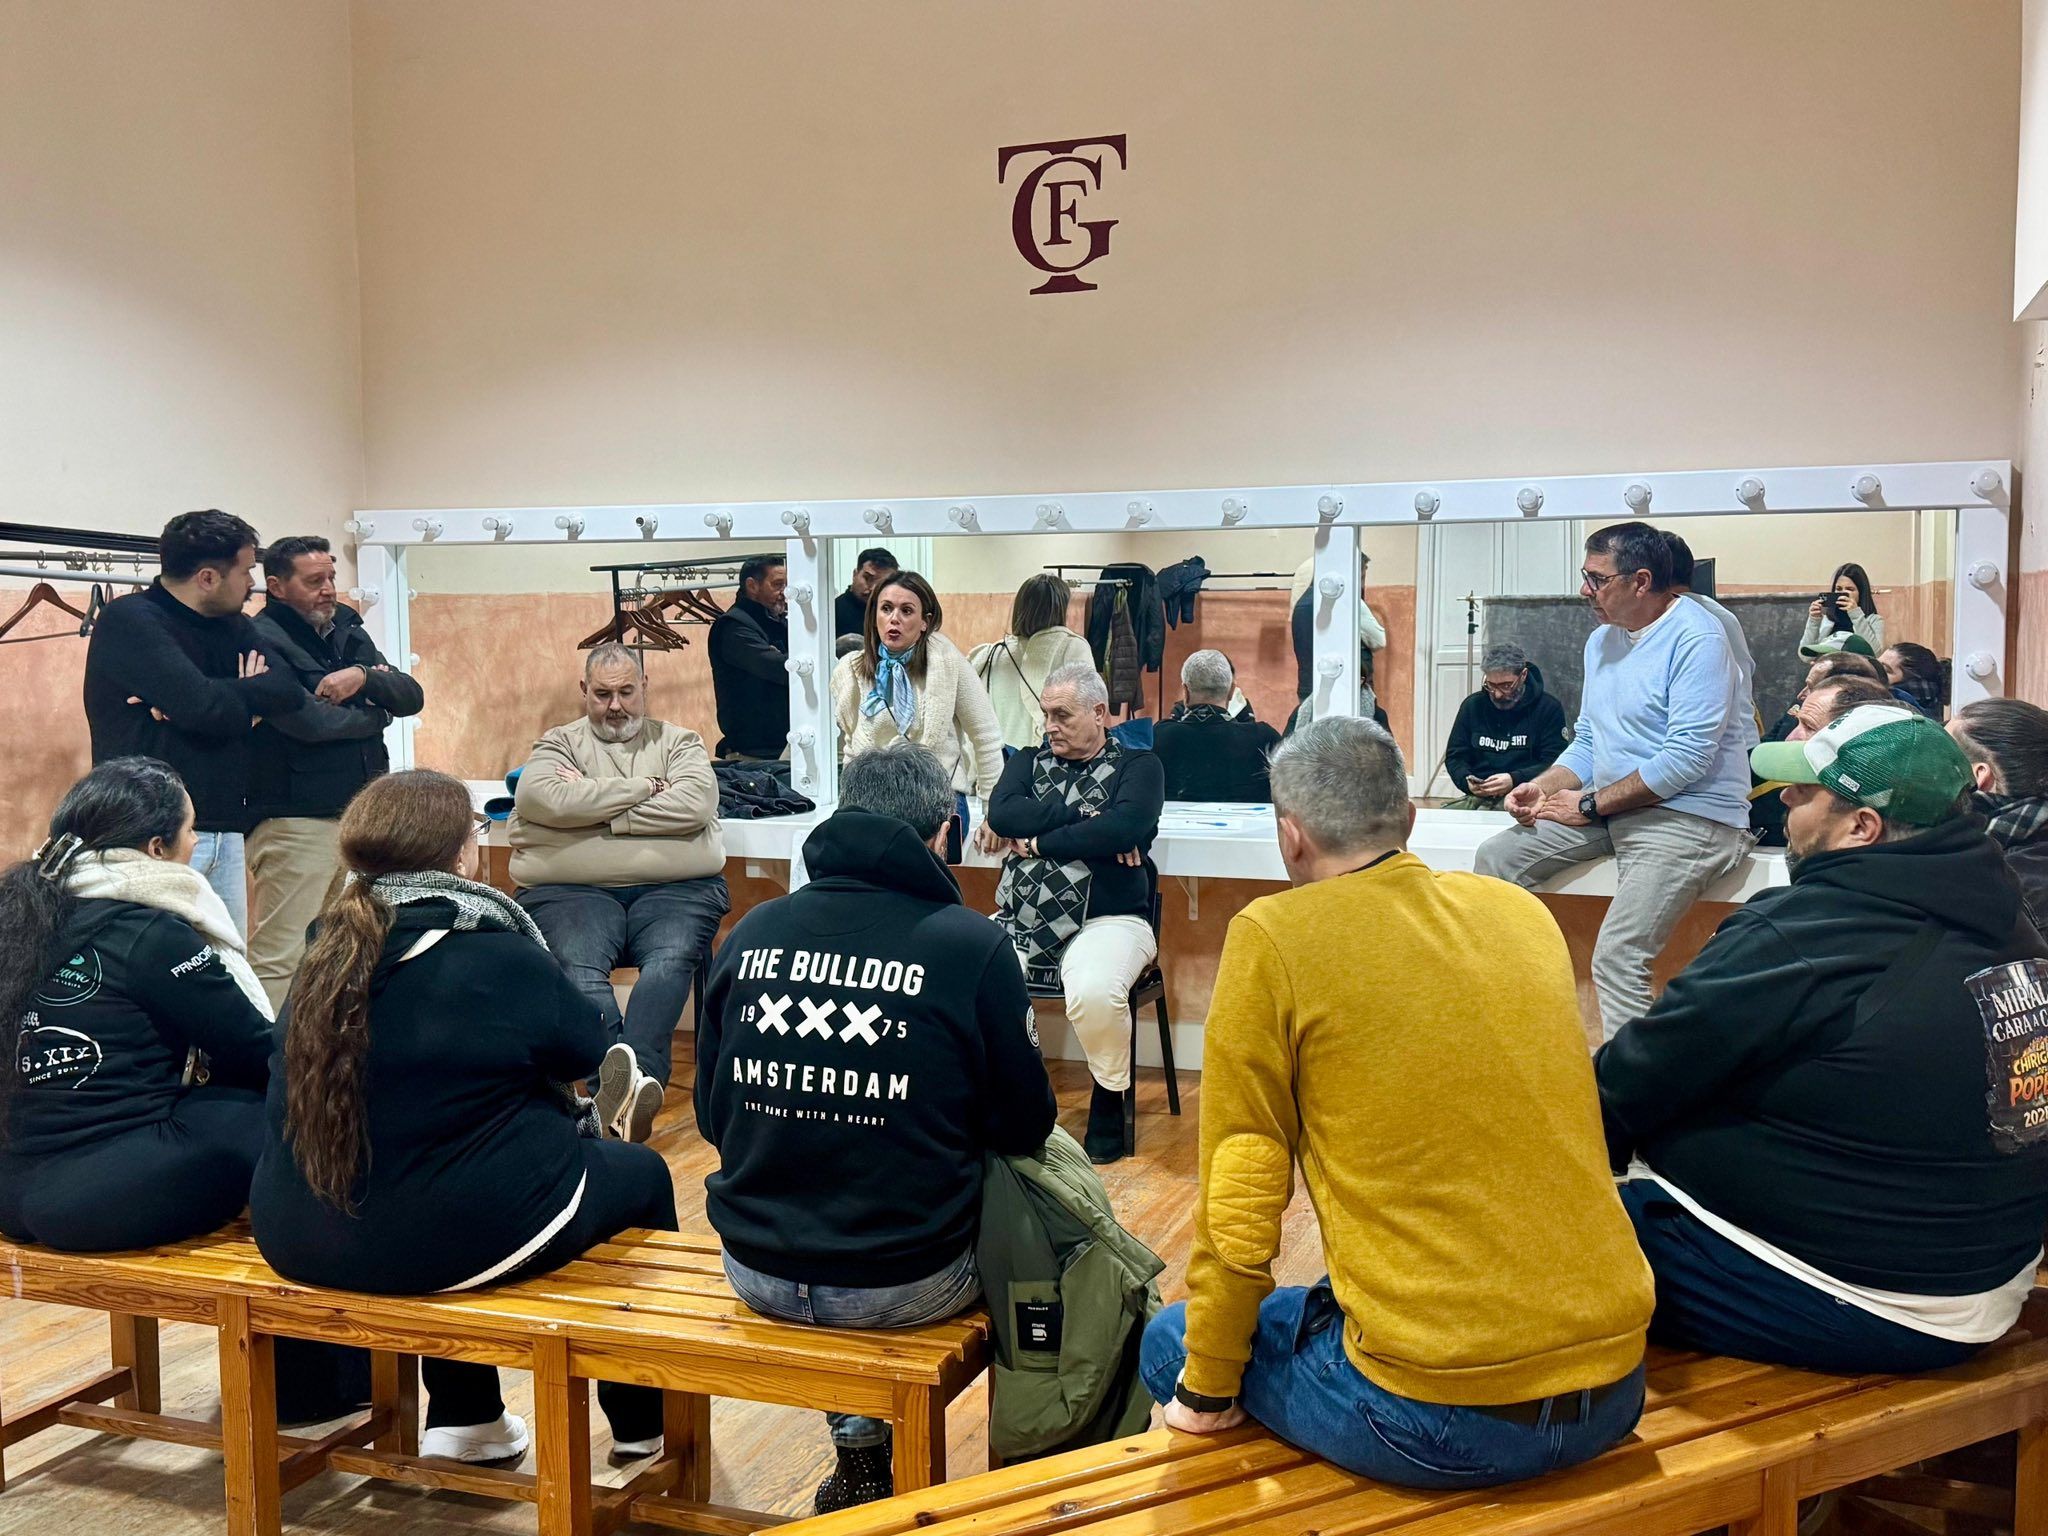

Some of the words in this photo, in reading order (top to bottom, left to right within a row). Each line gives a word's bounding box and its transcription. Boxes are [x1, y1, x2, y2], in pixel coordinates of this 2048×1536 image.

[170, 944, 213, 978] PANDOR
[737, 948, 784, 980] THE
[789, 950, 925, 996] BULLDOG
[1992, 1014, 2033, 1042] CARA
[29, 1072, 52, 1084] SINCE
[733, 1057, 909, 1100] AMSTERDAM
[796, 1109, 826, 1121] WITH
[833, 1112, 840, 1122] A
[848, 1114, 885, 1127] HEART
